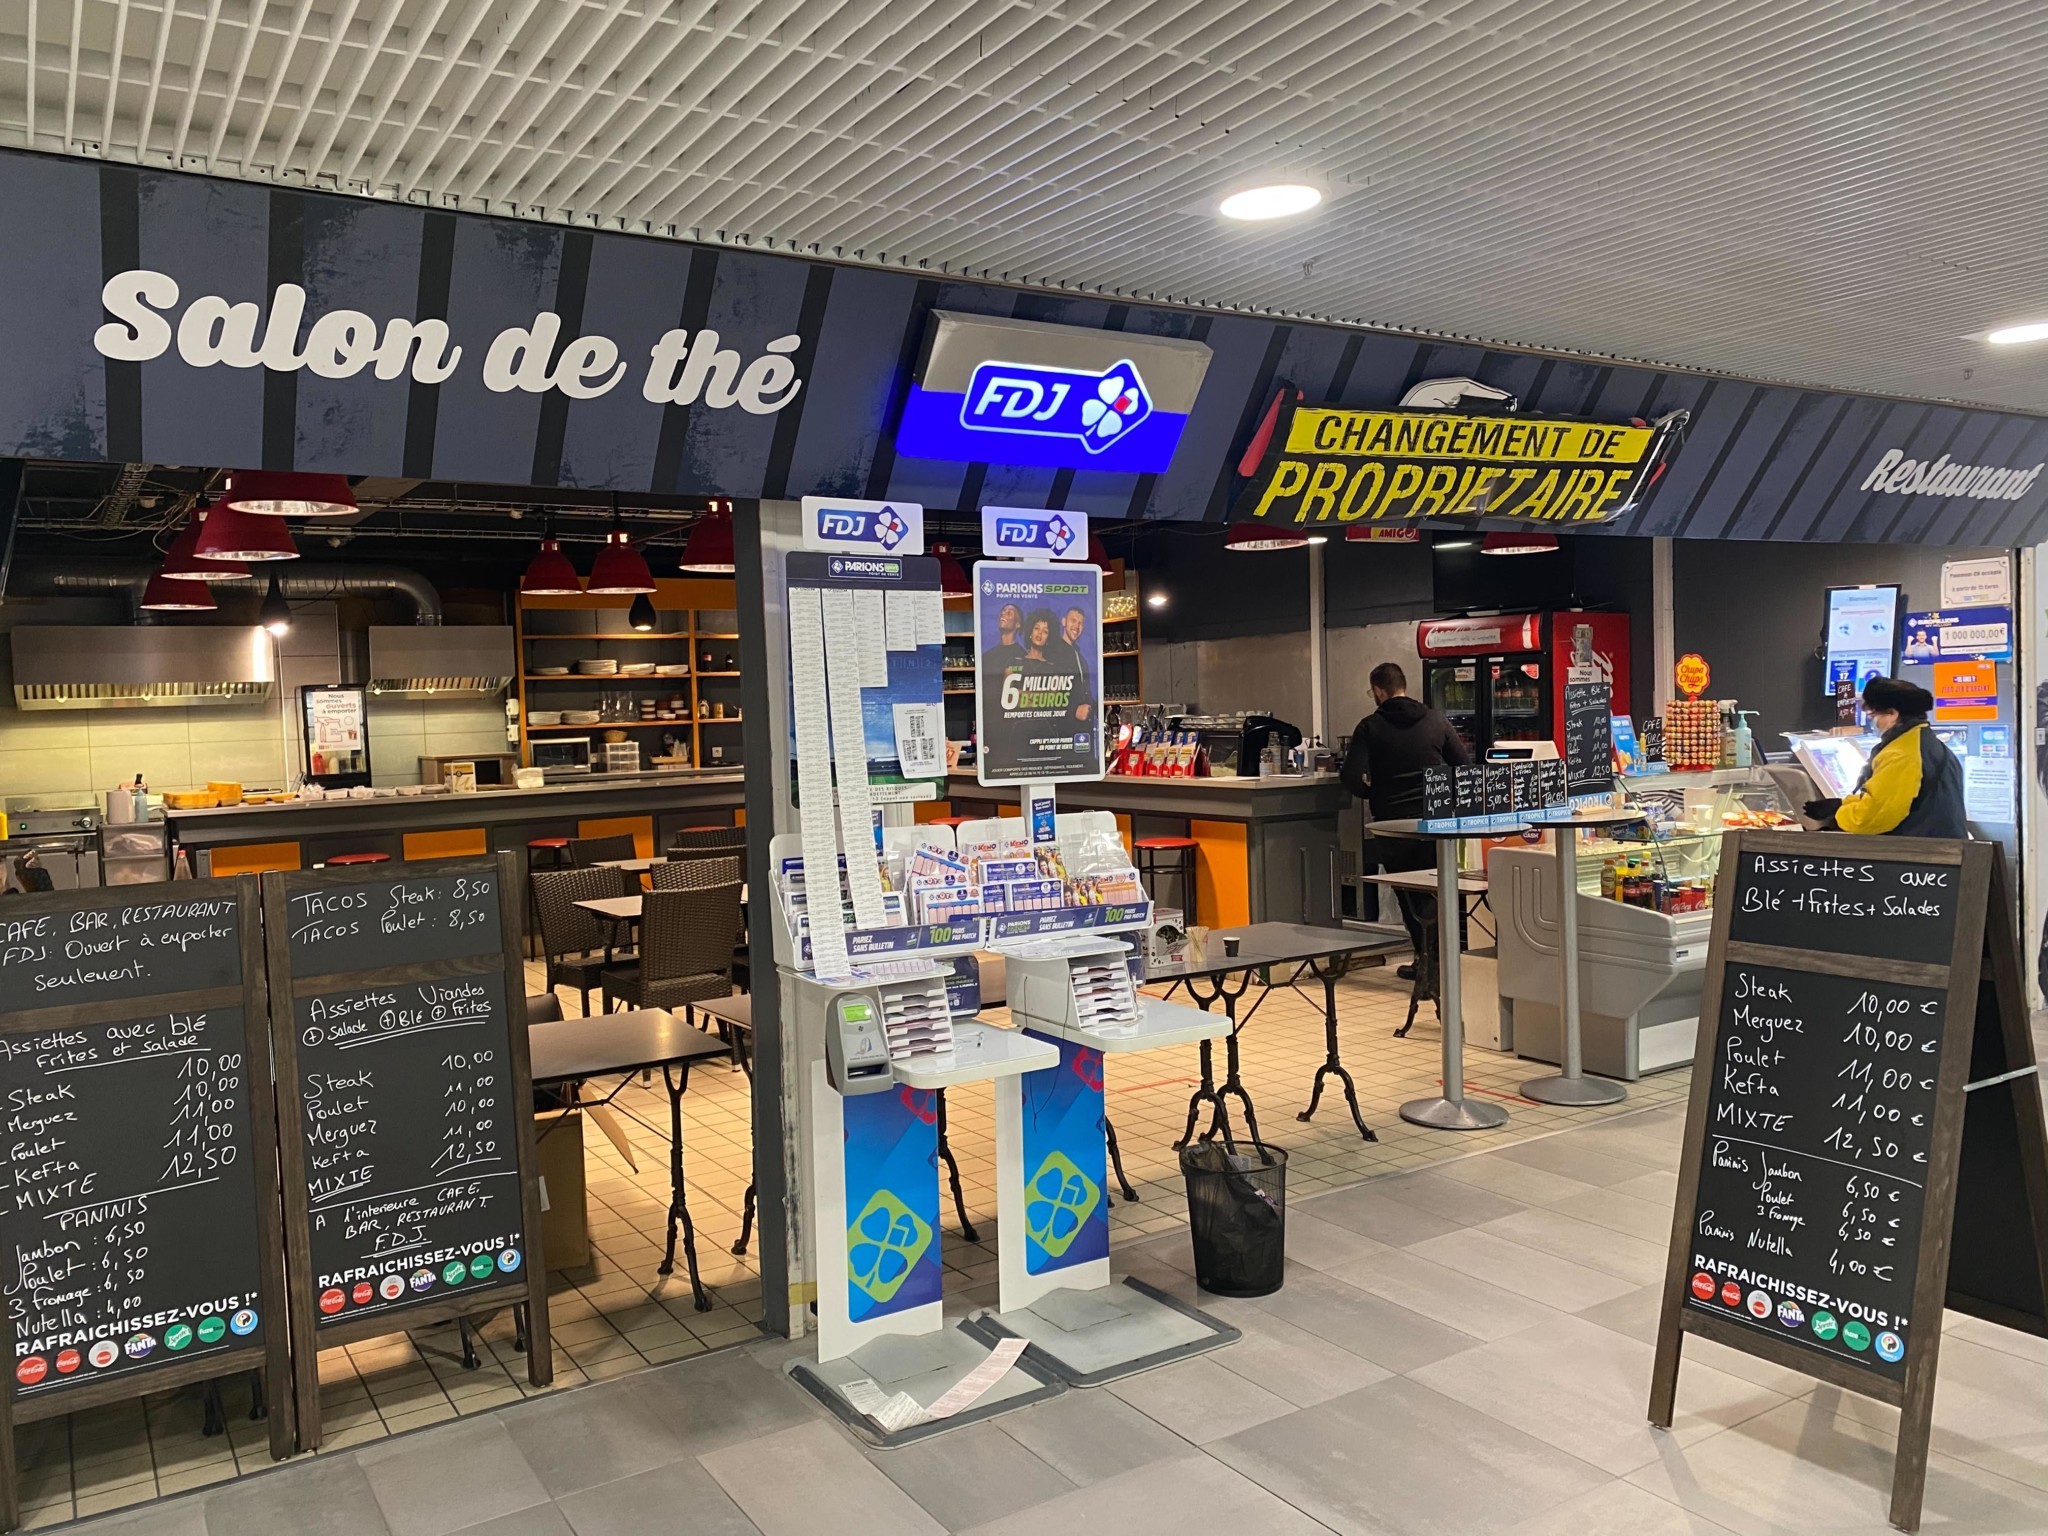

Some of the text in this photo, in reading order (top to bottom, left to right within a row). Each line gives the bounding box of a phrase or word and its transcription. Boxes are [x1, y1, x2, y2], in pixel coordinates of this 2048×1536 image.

[93, 270, 801, 415] Salon de thé
[974, 377, 1071, 421] FDJ
[1313, 415, 1626, 458] CHANGEMENT DE
[1861, 449, 2045, 500] Restaurant
[1253, 460, 1634, 522] PROPRIETAIRE
[821, 513, 866, 536] FDJ
[1000, 523, 1038, 544] FDJ
[1379, 528, 1416, 539] AMIGO
[845, 561, 885, 573] PARIONS
[996, 583, 1088, 594] PARIONS SPORT
[1952, 631, 1968, 640] 000
[1680, 674, 1704, 684] Chups
[1681, 665, 1704, 674] Chupa
[1000, 673, 1075, 710] 6 MILLIONS
[1019, 692, 1070, 709] D'EUROS
[1642, 720, 1661, 732] CAFE
[1592, 765, 1610, 778] 12,50
[1434, 820, 1458, 828] TROPICO
[1467, 818, 1489, 826] TROPICO
[1496, 816, 1517, 824] TROPICO
[1525, 812, 1545, 820] TROPICO
[1551, 808, 1572, 818] TROPICO
[1754, 855, 1948, 888] Assiettes avec
[291, 891, 368, 917] TACOS
[452, 878, 490, 902] 8,50
[1741, 887, 1940, 917] Blé Salades
[122, 902, 236, 926] RESTAURANT
[291, 909, 486, 944] TACOS 8,50
[1038, 920, 1074, 930] SANS BULLETIN
[1040, 916, 1058, 924] PARIEZ
[1105, 908, 1124, 922] 100
[65, 936, 129, 959] Ouvert
[140, 934, 155, 947] à
[161, 924, 232, 953] emporter
[853, 935, 873, 944] PARIEZ
[853, 941, 894, 952] SANS BULLETIN
[930, 927, 952, 944] 100
[310, 983, 485, 1022] Assiettes Viandes
[1735, 973, 1910, 1023] Steak 10,00
[327, 999, 492, 1041] Salade Blé Frites
[1733, 1005, 1912, 1053] Merguez 10,00
[0, 1014, 207, 1061] Assiettes avec blé
[36, 1048, 98, 1069] Frites
[112, 1042, 132, 1056] et
[177, 1054, 242, 1082] 10,00
[441, 1050, 494, 1071] 10,00
[1726, 1036, 1912, 1093] Poulet 11,00
[8, 1077, 239, 1112] Steak 10,00
[303, 1069, 494, 1101] Steak 11,00
[1724, 1063, 1901, 1124] Kefta 11,00
[7, 1099, 235, 1136] Merguez 11,00
[306, 1095, 495, 1122] Poulet 10,00
[11, 1123, 233, 1161] Poulet 11,00
[306, 1119, 493, 1149] Merguez 11,00
[1716, 1103, 1898, 1159] MIXTE 12,50
[14, 1145, 237, 1186] Kefta 12,50
[312, 1140, 496, 1170] Kefta 12,50
[1711, 1140, 1880, 1200] Paninis Jambon 6,50
[16, 1172, 97, 1211] MIXTE
[307, 1164, 375, 1197] MIXTE
[59, 1195, 148, 1231] PANINIS
[1760, 1181, 1877, 1225] Poulet 6,50
[105, 1221, 145, 1246] 6,50
[315, 1214, 326, 1232] A
[1756, 1205, 1765, 1216] 3
[1838, 1221, 1872, 1242] 6,50
[1698, 1209, 1867, 1276] Paninis Nutella 4,00
[101, 1247, 149, 1271] 6,50
[318, 1237, 505, 1289] RAFRAICHISSEZ-VOUS
[446, 1264, 466, 1280] Sprite
[8, 1268, 145, 1320] 3 6,50
[409, 1272, 437, 1289] FANTA
[1694, 1253, 1888, 1328] RAFRAICHISSEZ-VOUS
[15, 1296, 240, 1357] RAFRAICHISSEZ-VOUS
[16, 1296, 142, 1339] Nutella 4,00
[1777, 1303, 1805, 1324] FANTA
[1814, 1318, 1837, 1333] Sprite
[124, 1338, 157, 1356] FANTA
